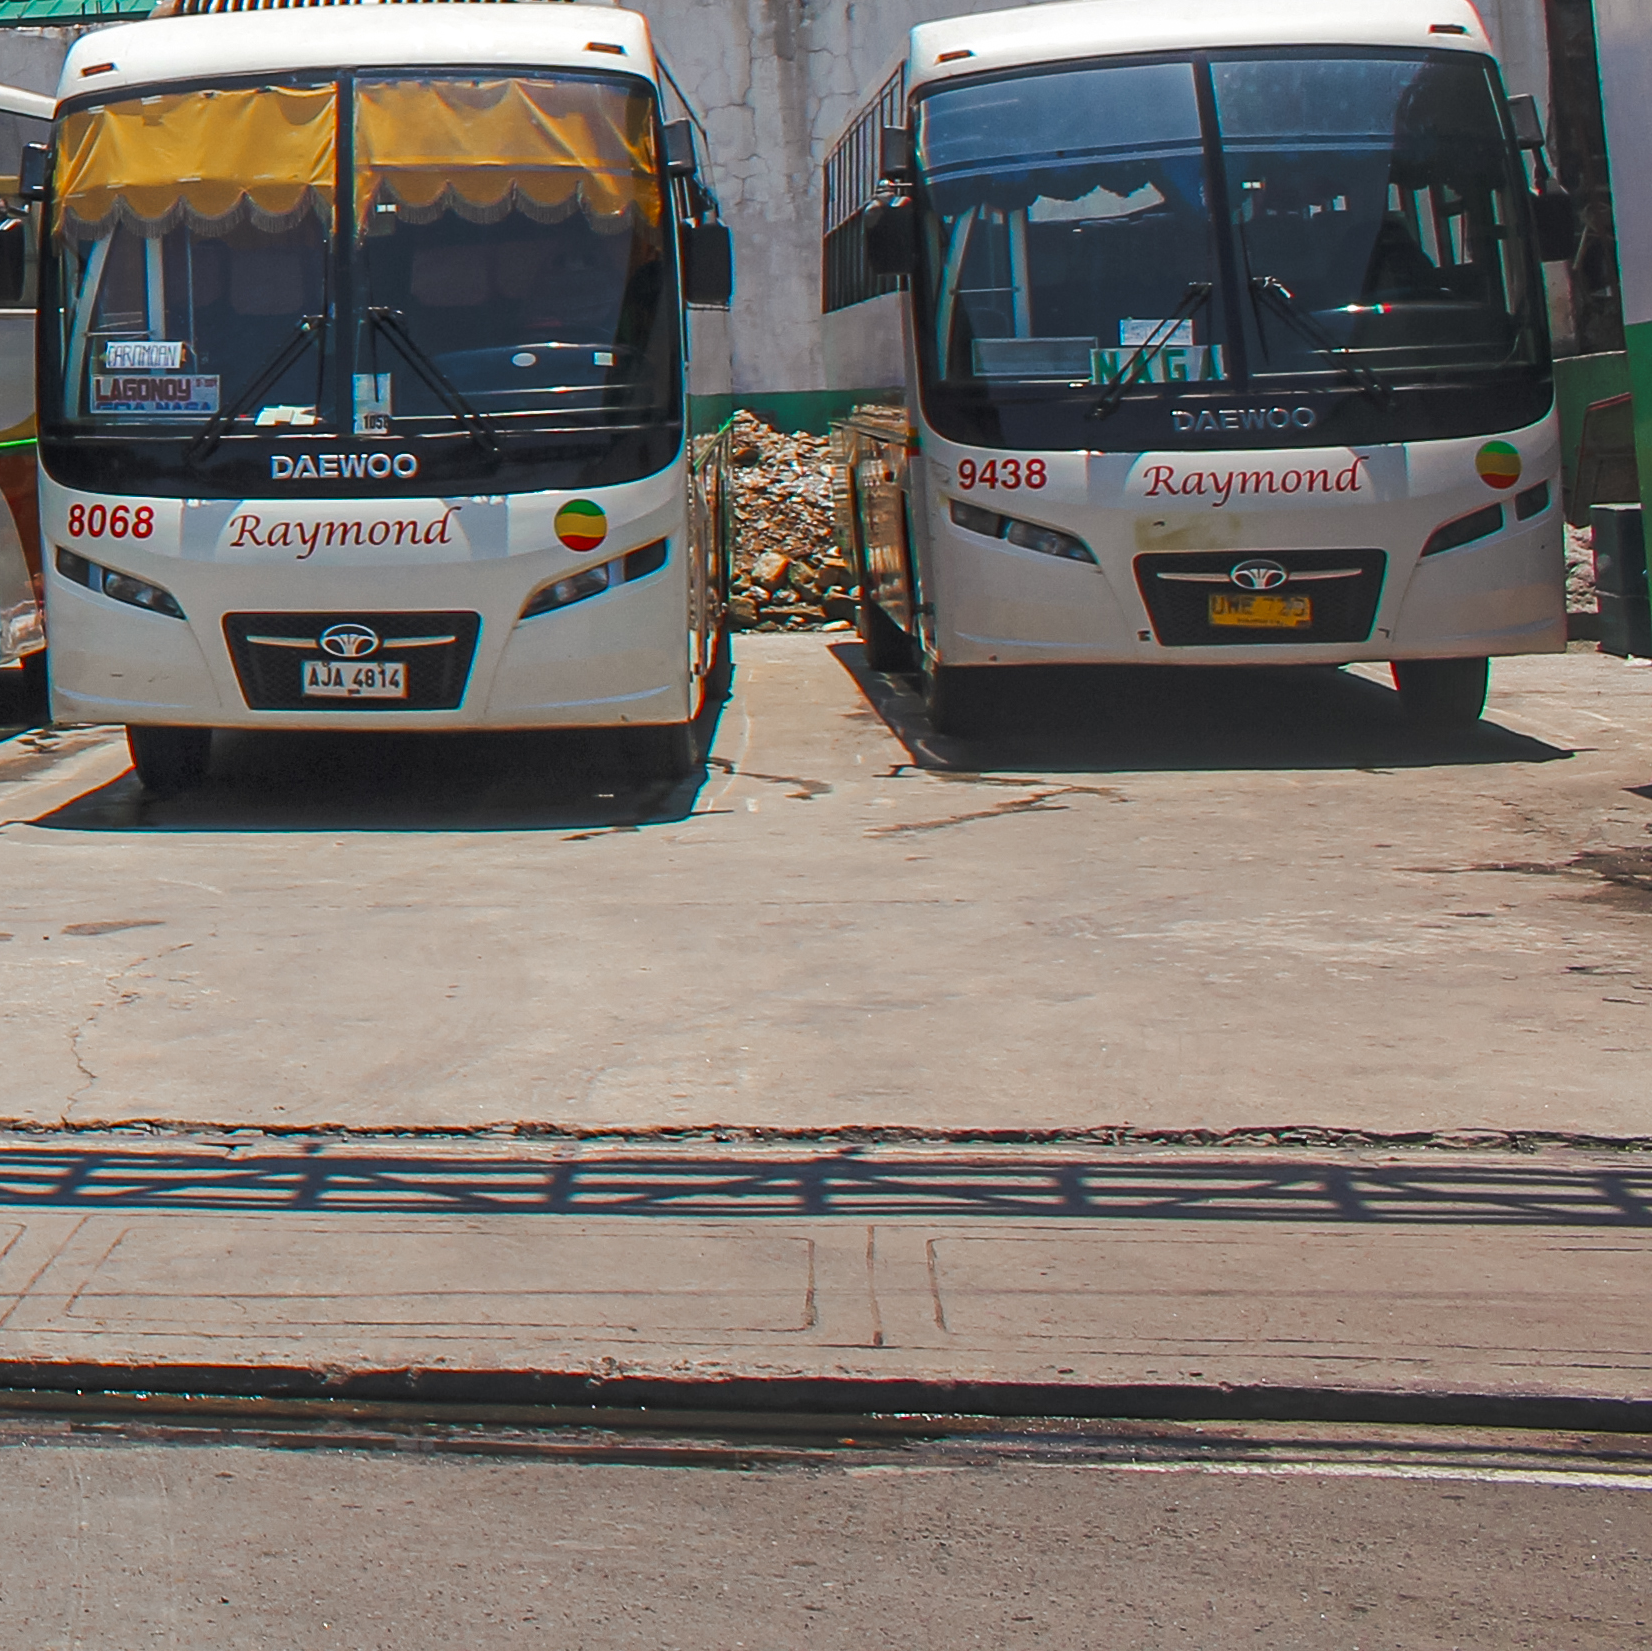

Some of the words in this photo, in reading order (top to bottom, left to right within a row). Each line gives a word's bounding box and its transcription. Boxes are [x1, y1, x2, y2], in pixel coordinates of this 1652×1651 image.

[1095, 351, 1223, 382] NAGA
[96, 378, 192, 402] LAGONOY
[1170, 406, 1317, 432] DAEWOO
[270, 453, 419, 480] DAEWOO
[957, 458, 1048, 490] 9438
[1143, 455, 1370, 508] Raymond
[68, 504, 155, 539] 8068
[229, 506, 463, 560] Raymond
[308, 666, 345, 687] AJA
[351, 667, 401, 689] 4814
